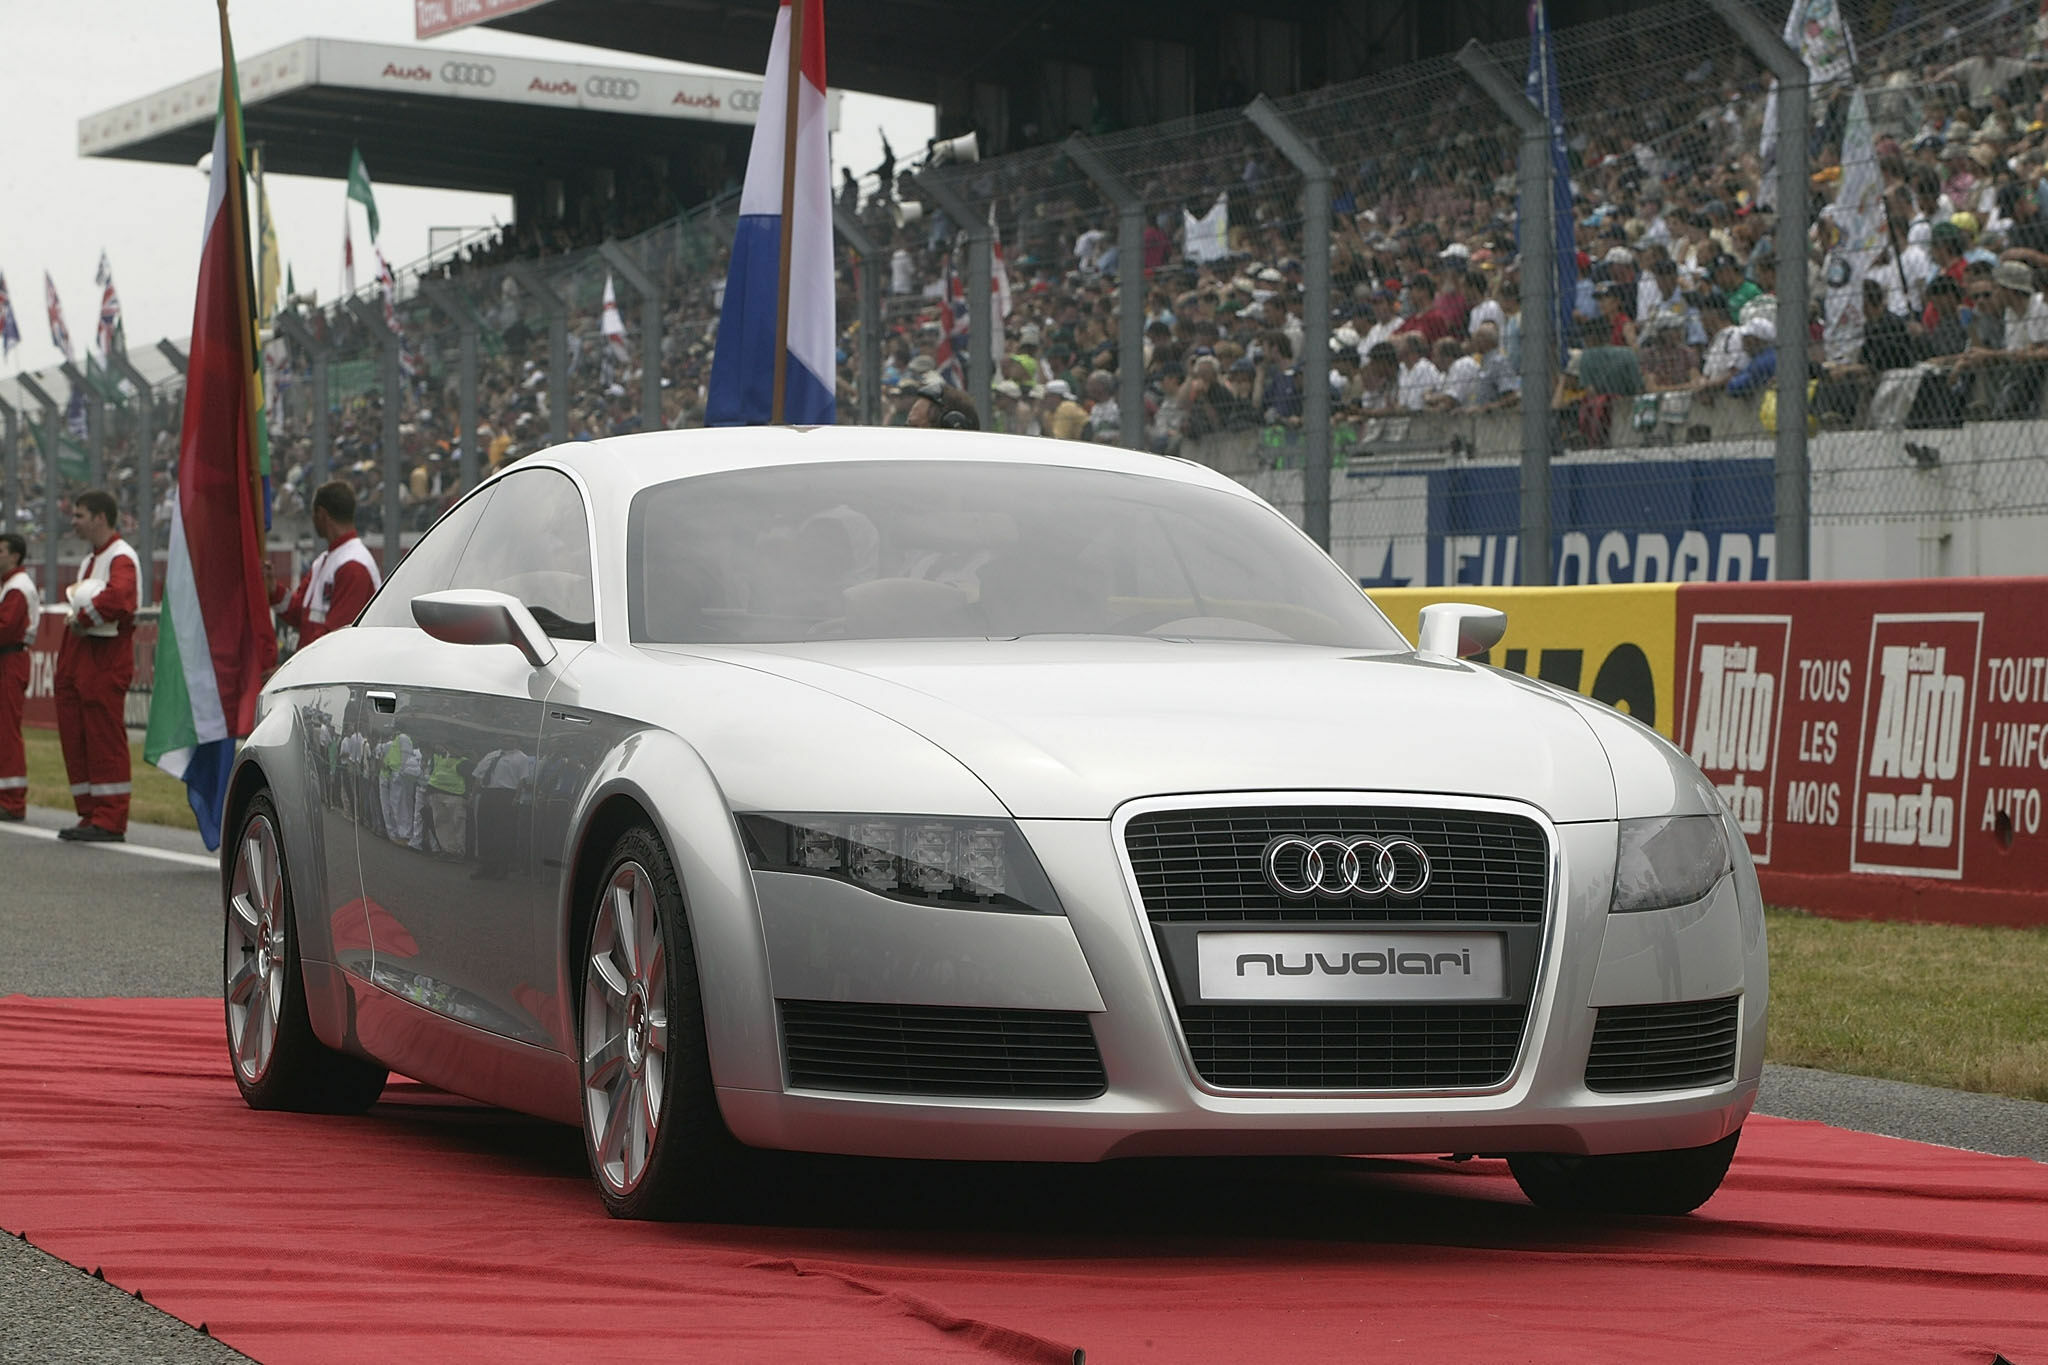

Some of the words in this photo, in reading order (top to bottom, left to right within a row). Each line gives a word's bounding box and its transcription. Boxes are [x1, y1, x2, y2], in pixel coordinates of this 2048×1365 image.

[382, 62, 432, 82] Audi
[527, 77, 577, 96] Audi
[671, 91, 721, 109] Audi
[1441, 530, 1776, 588] EUOSPORT
[1799, 659, 1851, 703] TOUS
[1869, 645, 1965, 780] Auto
[1799, 720, 1839, 765] LES
[1787, 780, 1841, 826] MOIS
[1864, 783, 1954, 848] moto
[1236, 947, 1471, 976] nuvolari
